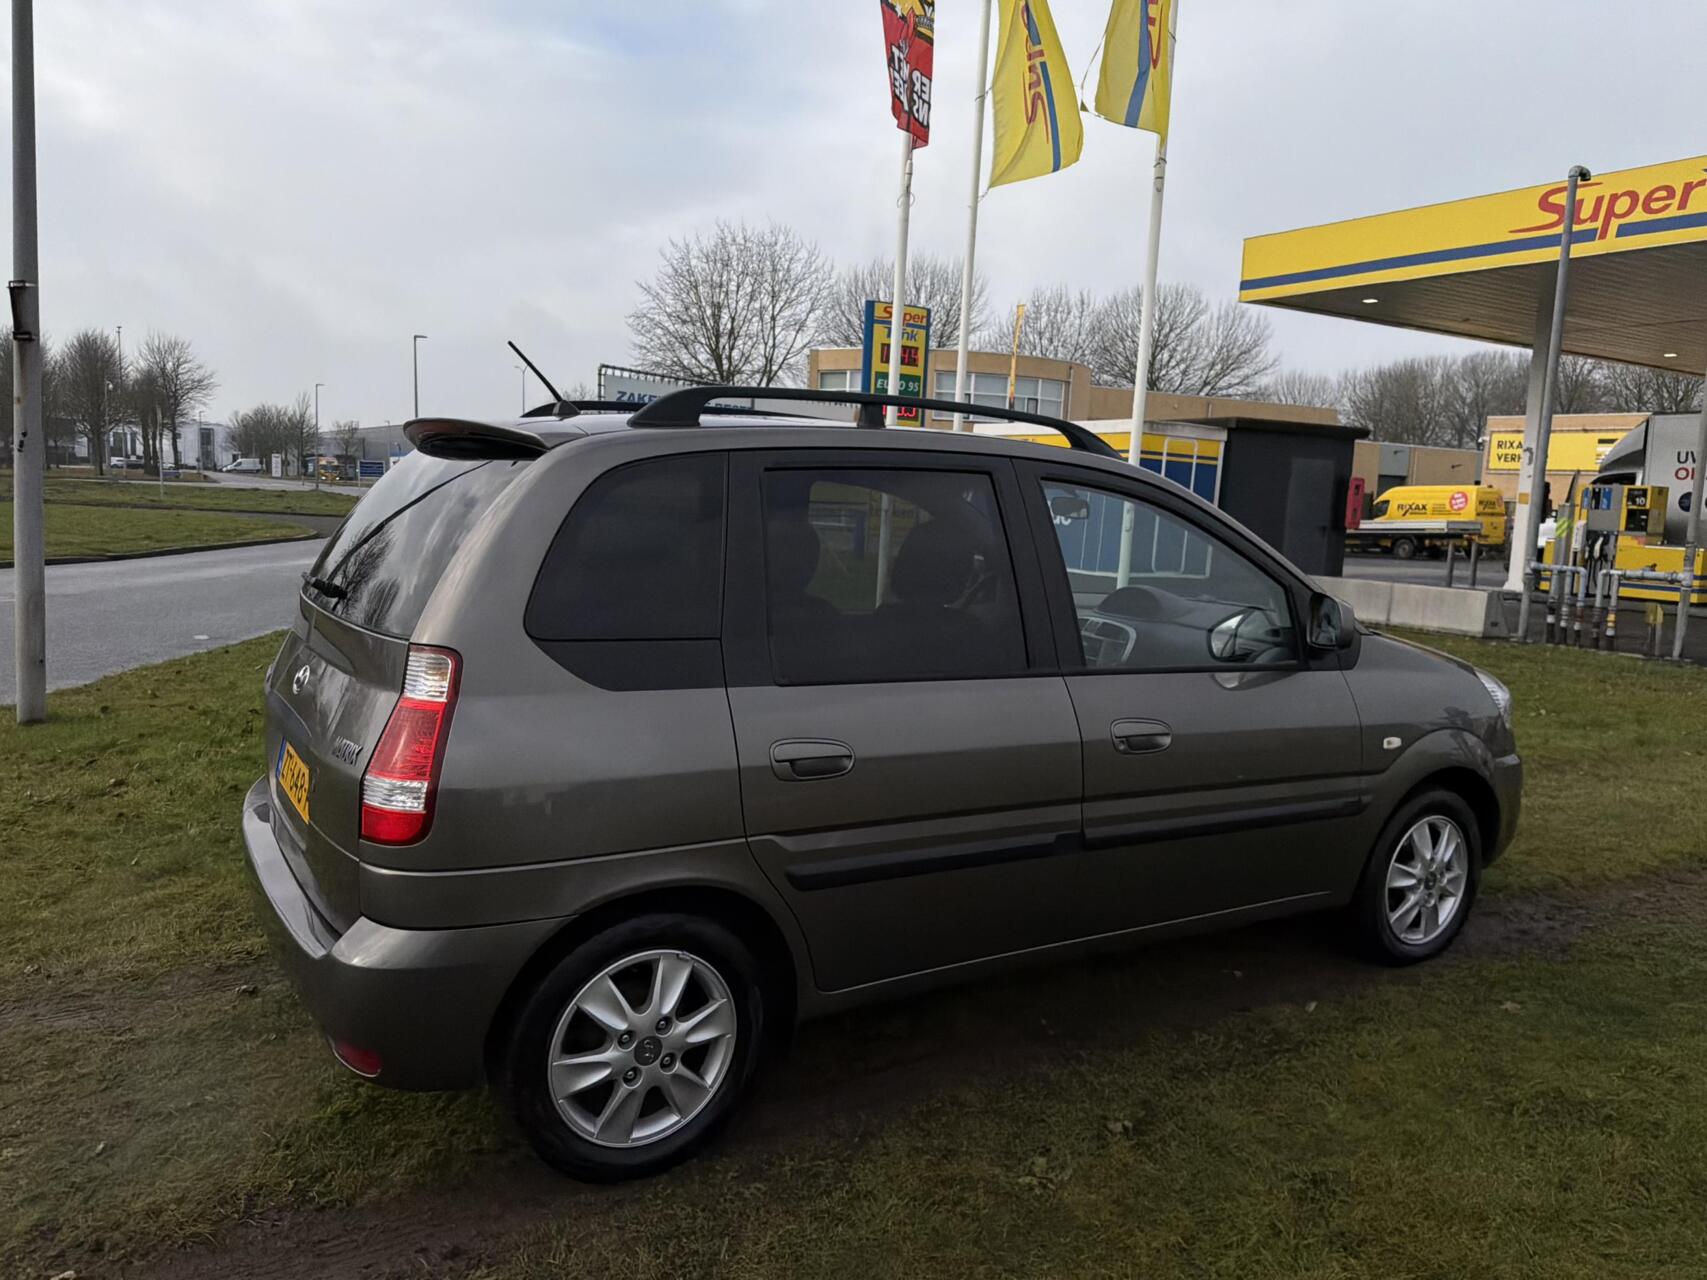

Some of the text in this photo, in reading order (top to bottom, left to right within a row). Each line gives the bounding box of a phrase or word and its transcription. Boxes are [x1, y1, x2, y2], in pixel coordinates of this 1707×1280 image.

[1508, 179, 1707, 241] Super
[876, 306, 927, 327] Sper
[884, 326, 919, 342] Tnk
[876, 378, 920, 392] EUO 95
[1496, 440, 1524, 450] RIXA
